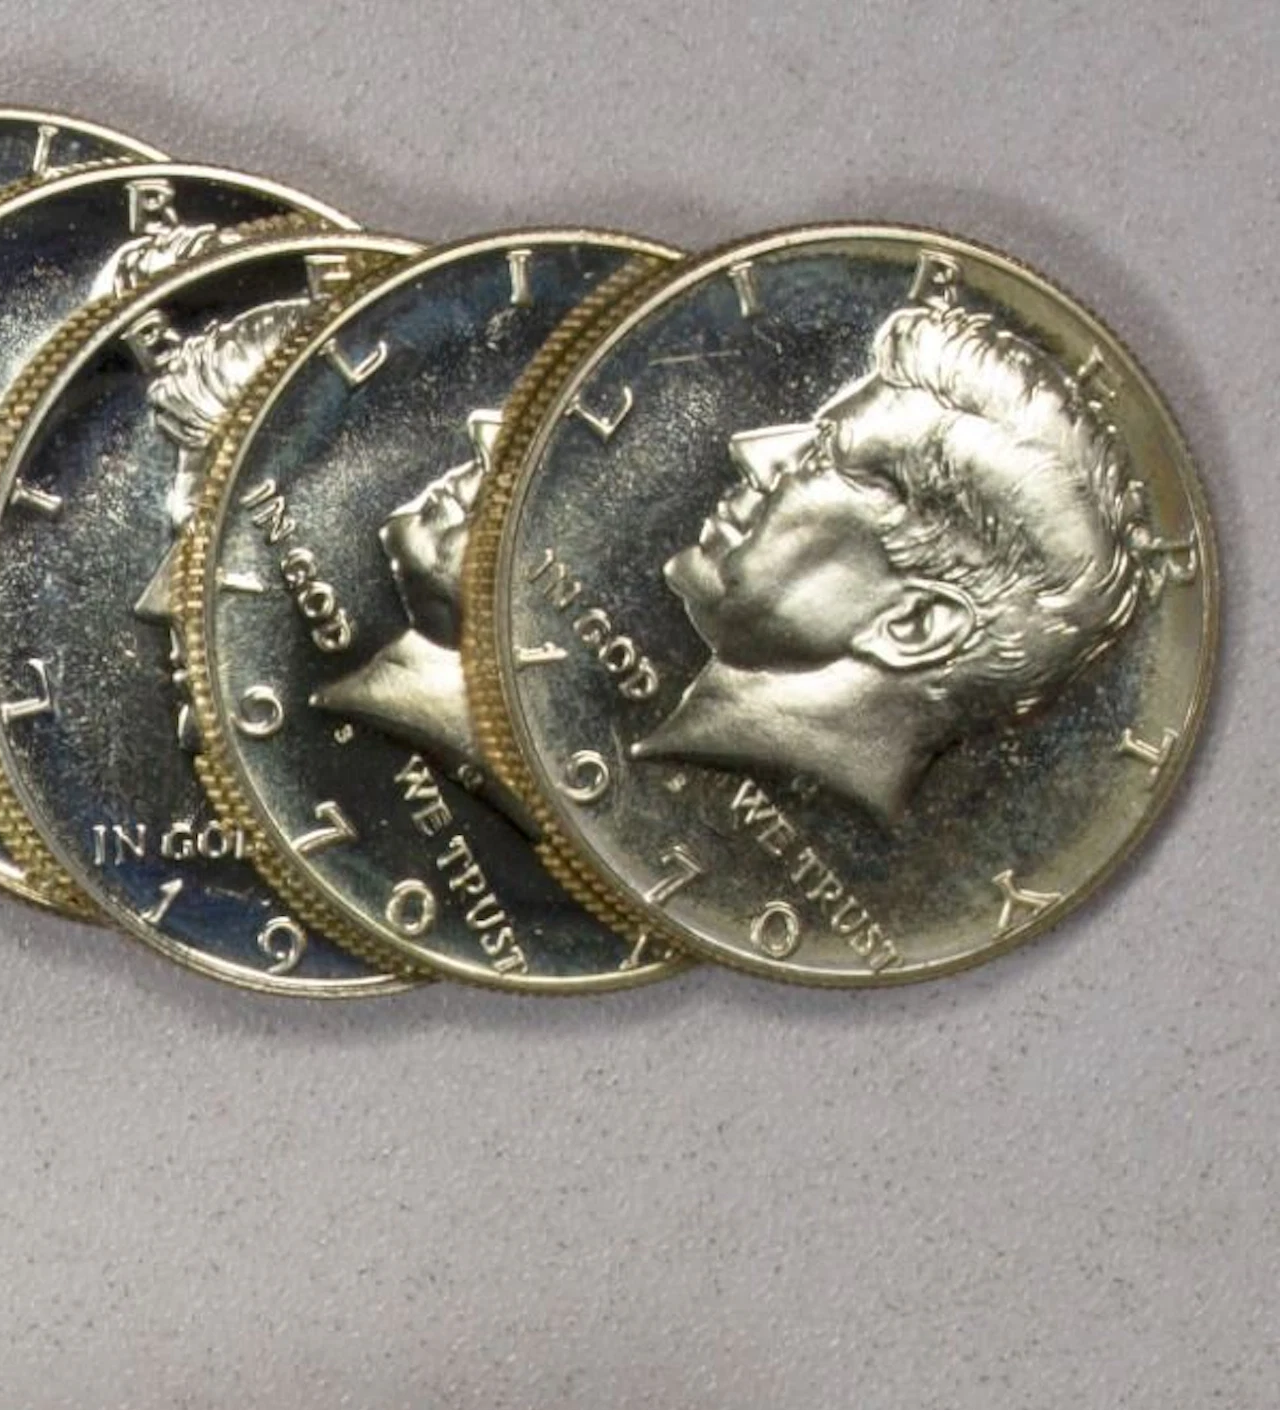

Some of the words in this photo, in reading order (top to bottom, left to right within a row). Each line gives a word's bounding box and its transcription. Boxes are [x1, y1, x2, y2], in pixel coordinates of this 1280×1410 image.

[280, 546, 353, 652] GOD
[573, 607, 659, 699] GOD
[214, 565, 435, 938] 1970
[513, 641, 803, 960] 1970
[92, 823, 148, 867] IN
[160, 819, 244, 861] GO
[394, 753, 453, 837] WE
[436, 833, 529, 978] TRUST
[789, 846, 905, 976] TRUST
